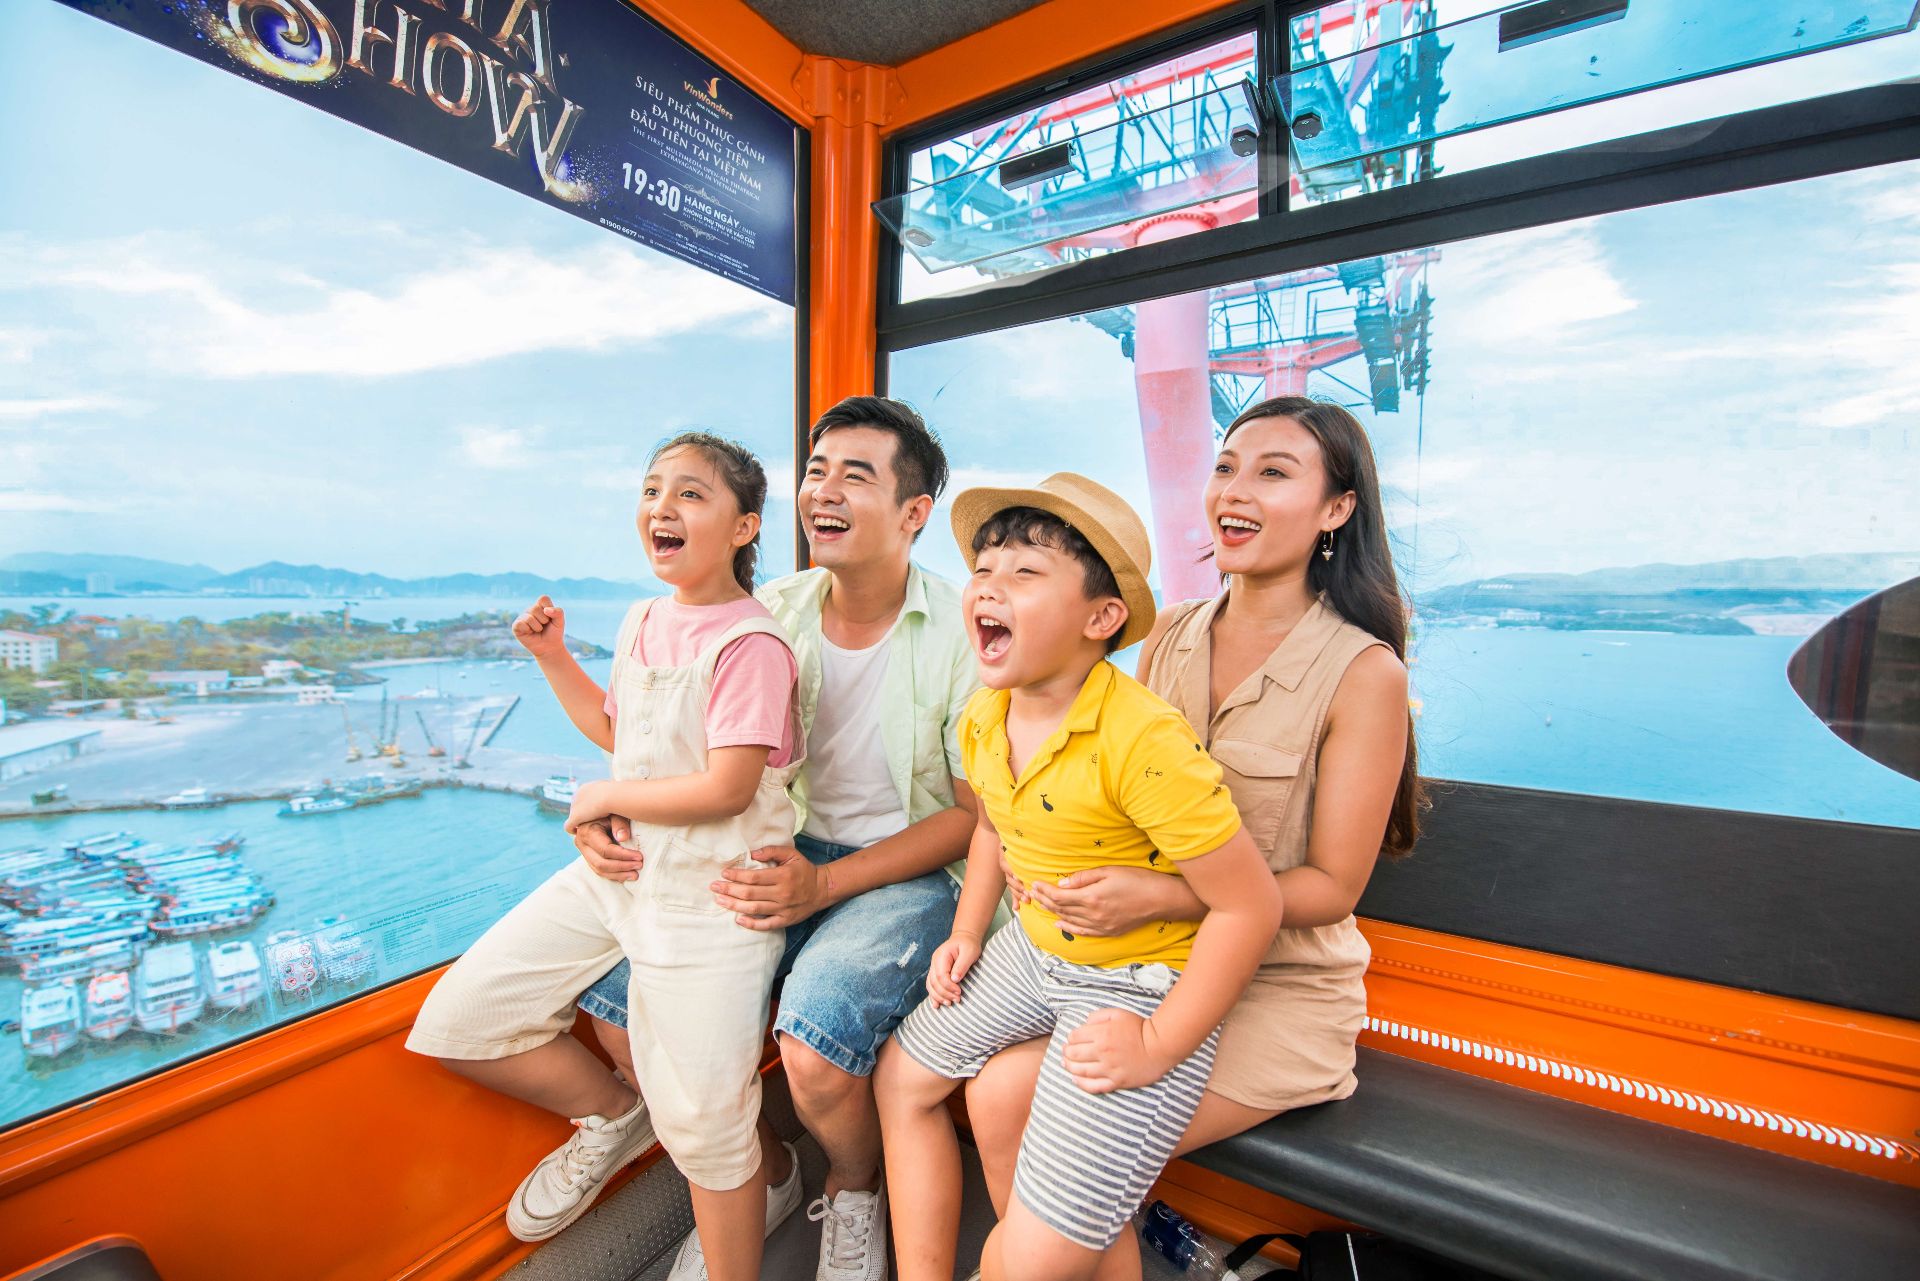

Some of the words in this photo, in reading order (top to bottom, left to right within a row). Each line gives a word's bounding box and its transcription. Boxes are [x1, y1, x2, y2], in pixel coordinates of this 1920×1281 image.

[635, 75, 664, 101] SIÊU
[704, 118, 735, 145] THỰC
[683, 80, 734, 120] VinWonders
[630, 108, 657, 131] ĐẦU
[660, 125, 688, 149] TIÊN
[692, 143, 709, 162] TẠI
[713, 154, 737, 177] VIỆT
[739, 171, 761, 191] NAM
[647, 134, 664, 148] FIRST
[665, 145, 702, 169] MULTIMEDIA
[652, 103, 669, 123] ĐA
[672, 116, 722, 153] PHƯƠNG
[725, 147, 749, 169] TIỆN
[622, 162, 681, 213] 19:30
[606, 219, 622, 231] 1900
